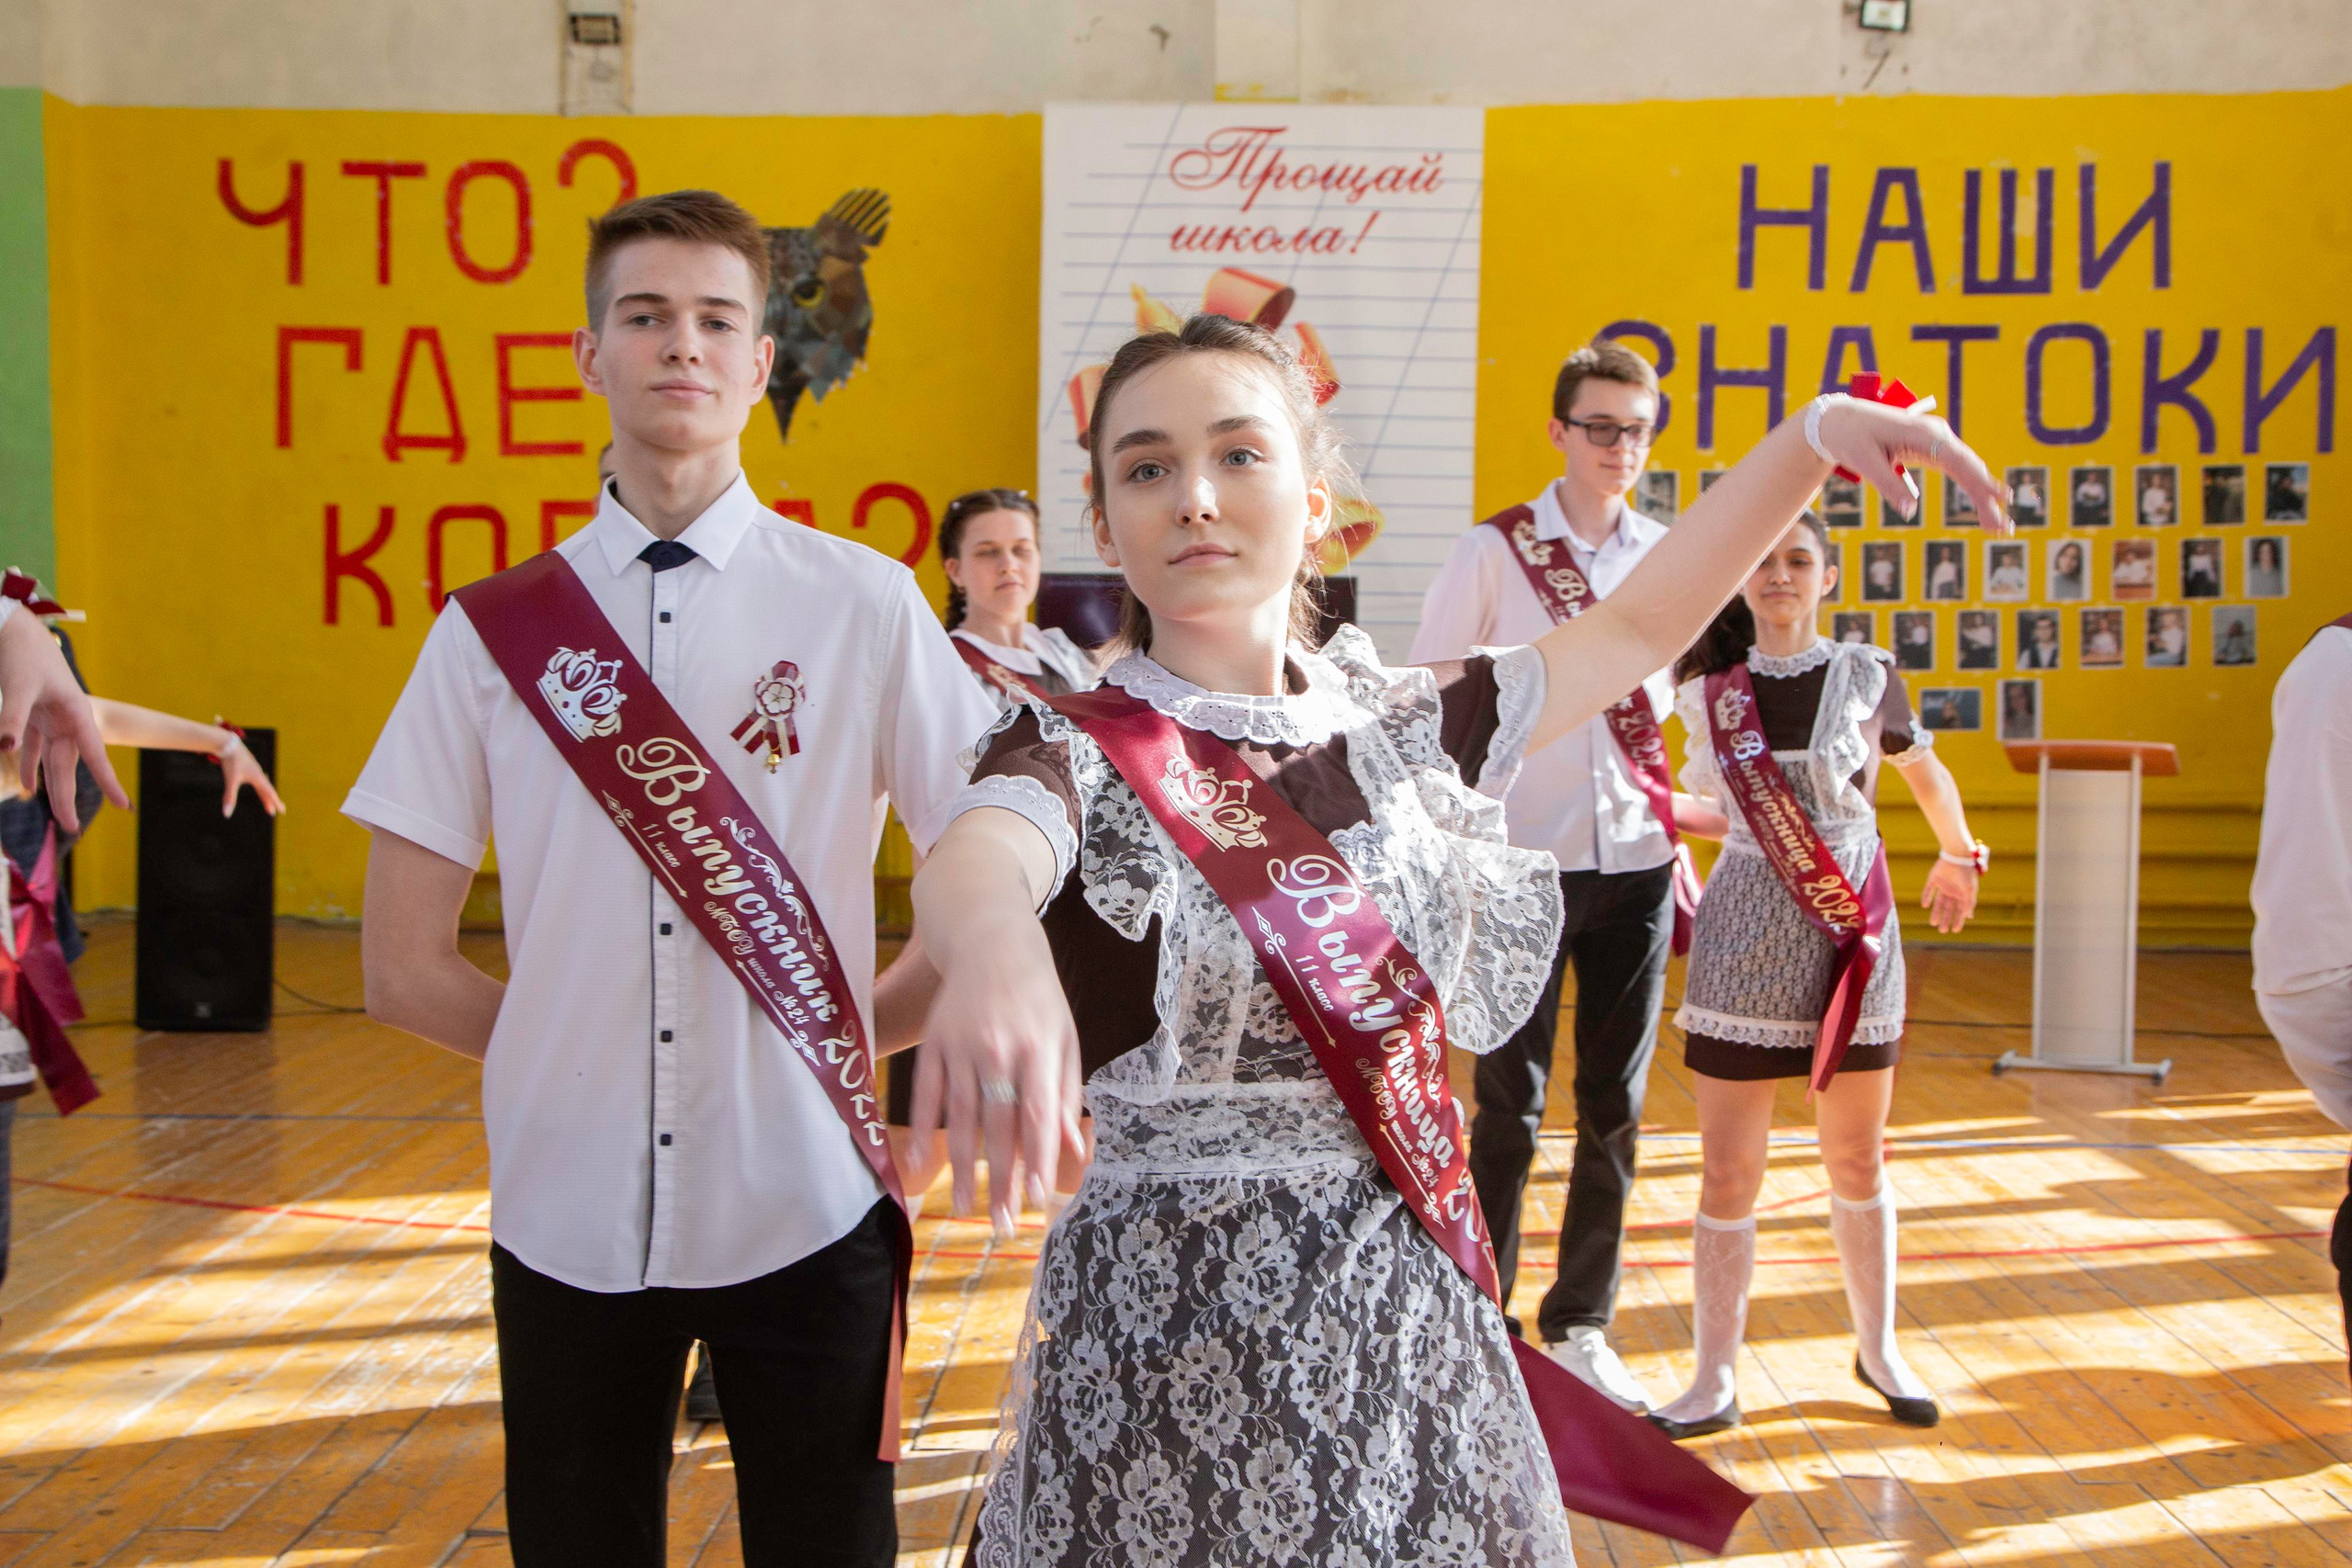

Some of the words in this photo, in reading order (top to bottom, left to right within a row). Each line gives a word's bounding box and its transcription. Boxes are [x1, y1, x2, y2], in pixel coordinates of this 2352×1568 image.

[1170, 125, 1444, 213] Прощай
[1169, 210, 1382, 254] школа!
[1736, 161, 2171, 295] НАШИ
[641, 823, 665, 839] 11
[616, 737, 839, 1022] Выпускник
[703, 901, 757, 955] МБОУ
[747, 957, 776, 989] школа
[1295, 954, 1320, 973] 11
[1308, 977, 1334, 1011] класс
[1266, 854, 1455, 1168] Выпускница
